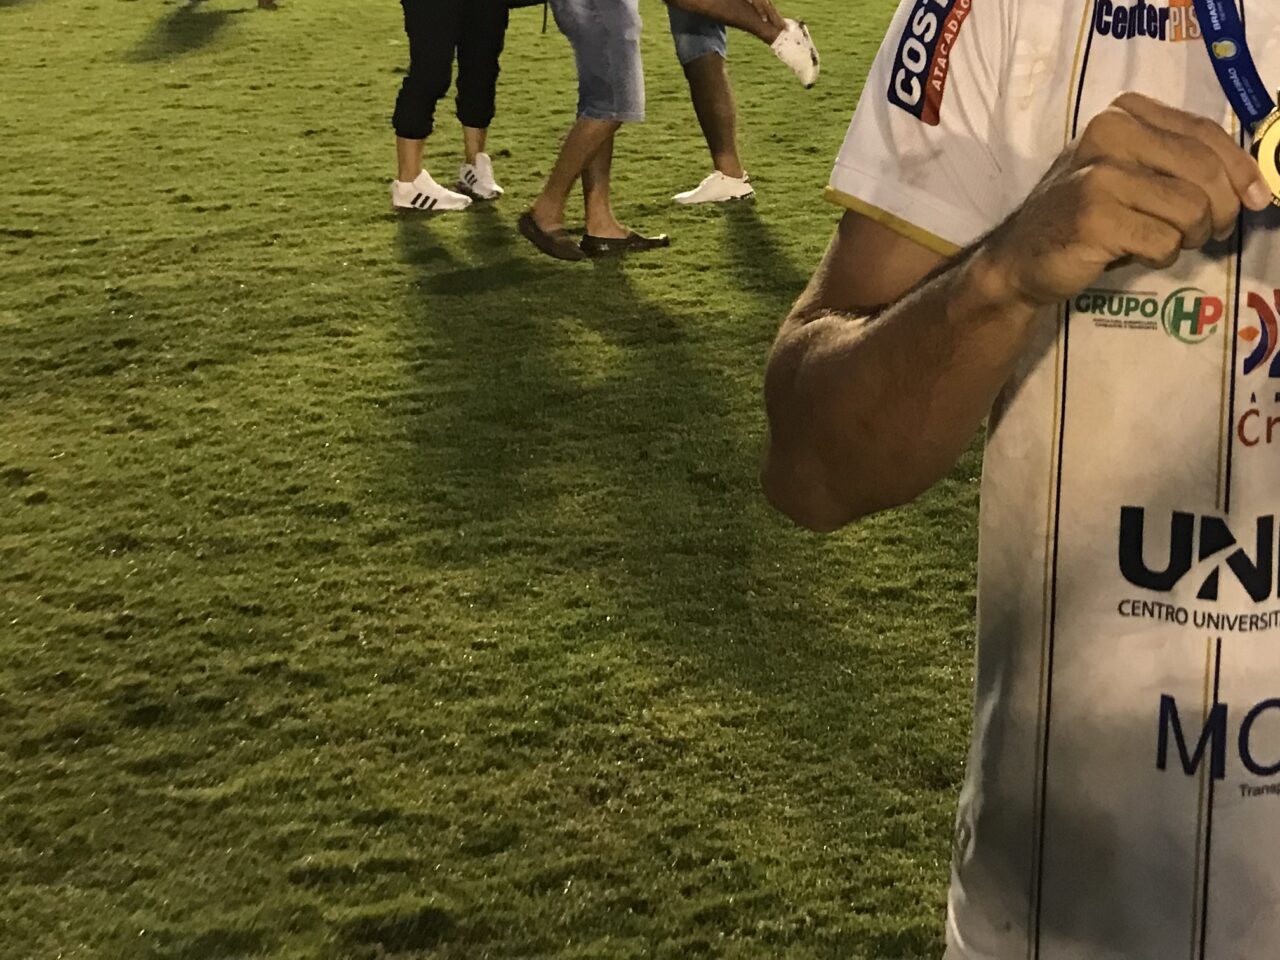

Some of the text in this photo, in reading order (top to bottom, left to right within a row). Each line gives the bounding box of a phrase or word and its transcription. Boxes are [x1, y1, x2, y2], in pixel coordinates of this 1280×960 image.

[1075, 293, 1223, 336] GRUPO HP
[1118, 598, 1189, 625] CENTRO
